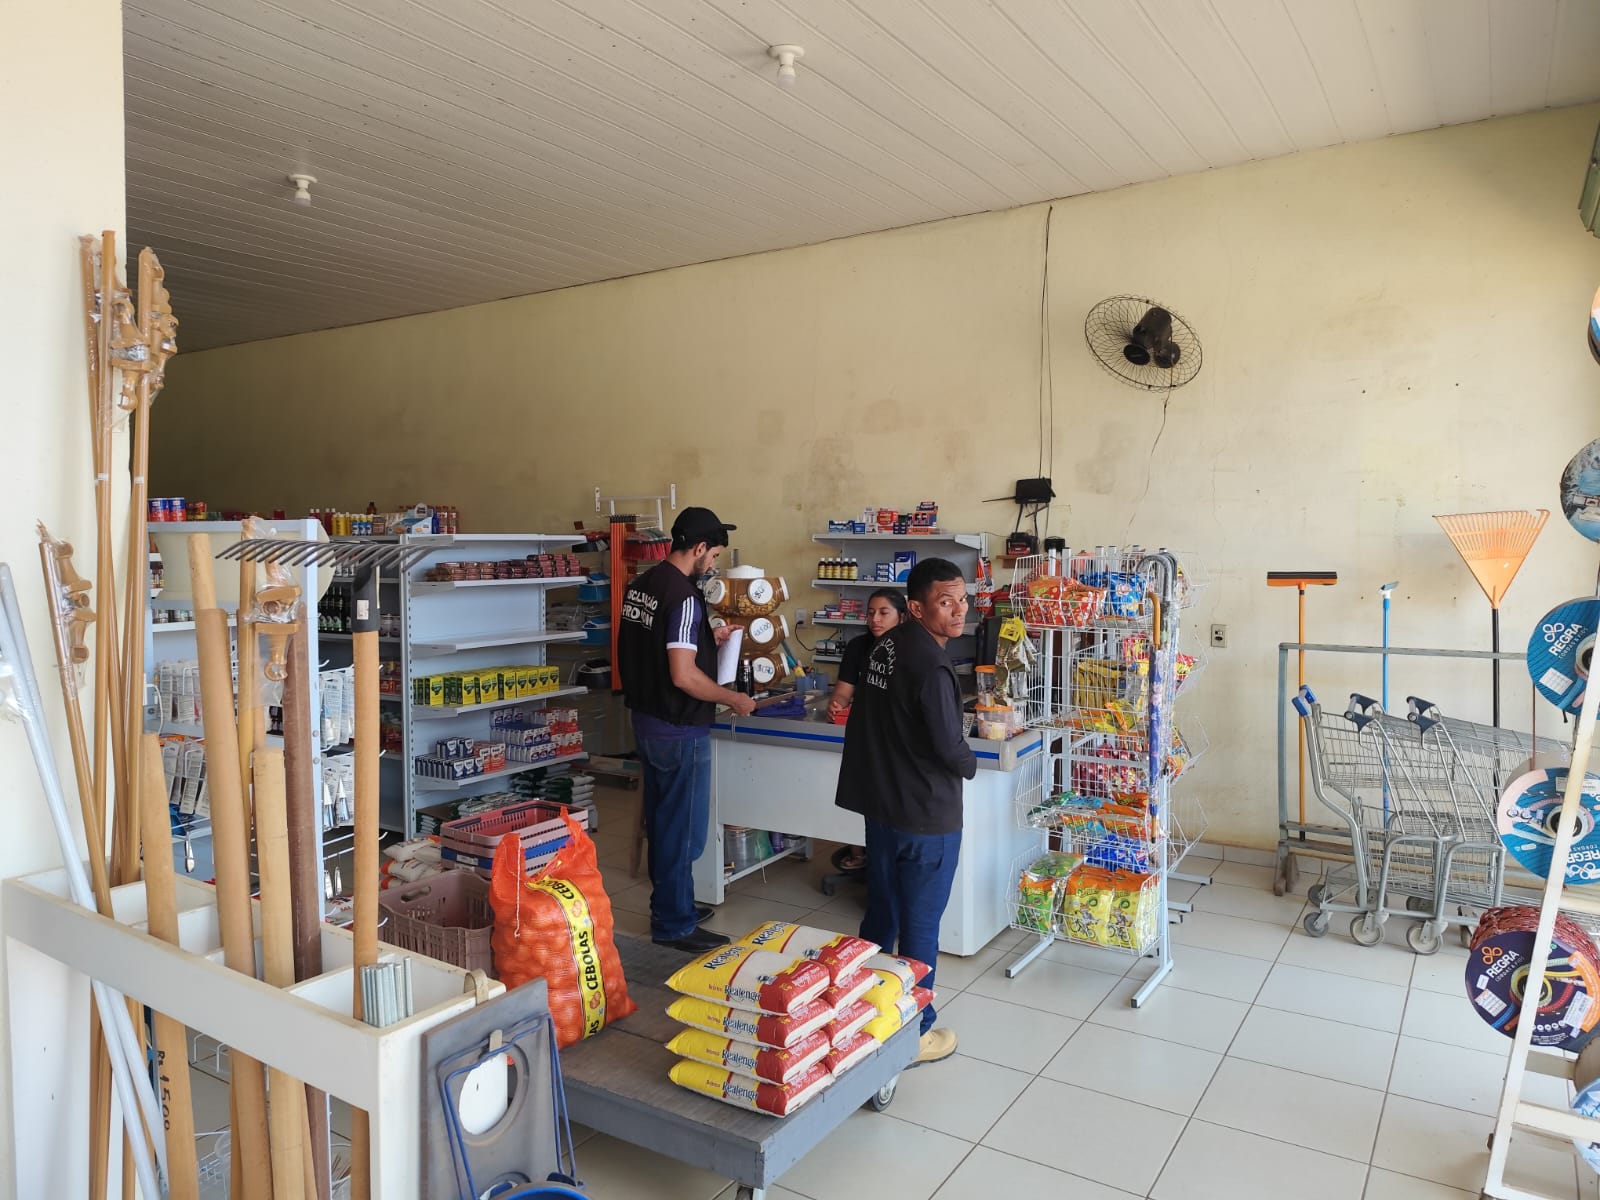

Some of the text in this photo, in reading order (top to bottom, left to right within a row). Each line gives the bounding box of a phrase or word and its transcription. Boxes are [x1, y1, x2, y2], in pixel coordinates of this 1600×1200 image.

[1548, 623, 1583, 657] REGRA
[1567, 849, 1600, 864] REGR
[578, 930, 599, 991] CEBOLAS
[1486, 950, 1520, 979] REGRA
